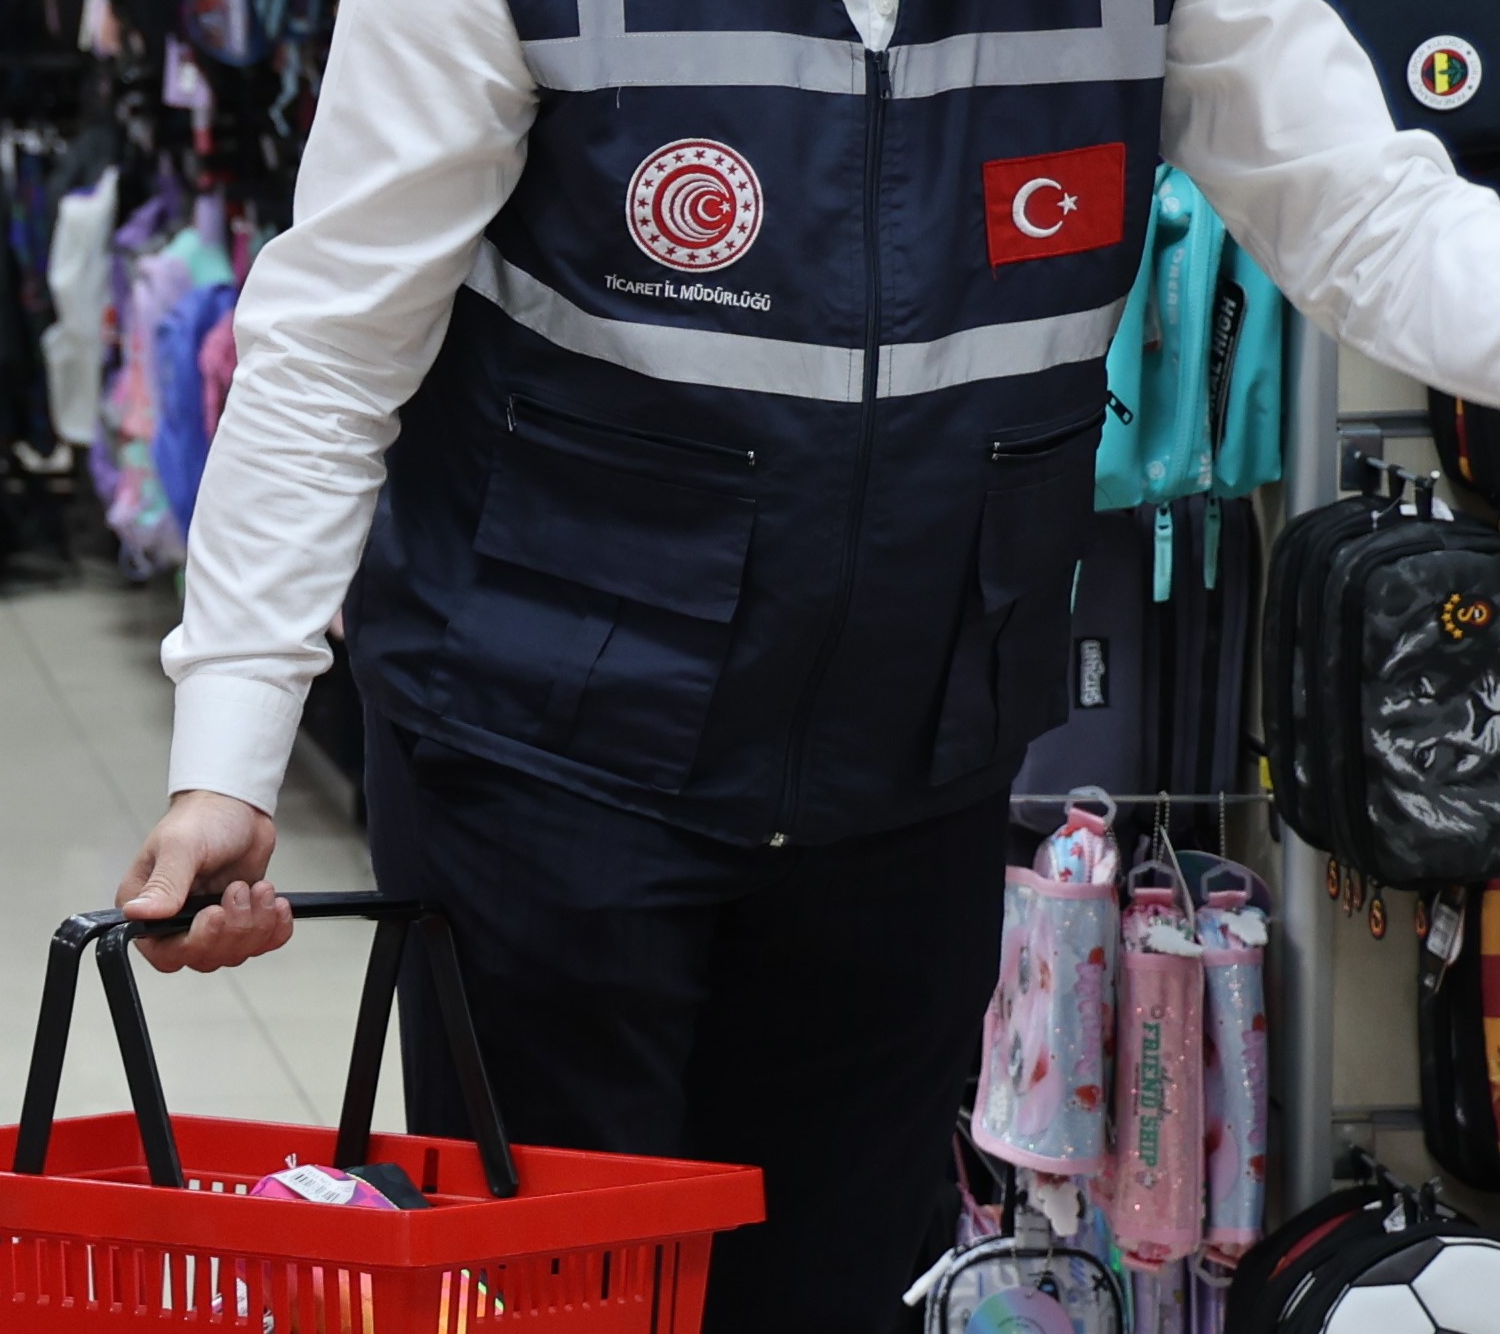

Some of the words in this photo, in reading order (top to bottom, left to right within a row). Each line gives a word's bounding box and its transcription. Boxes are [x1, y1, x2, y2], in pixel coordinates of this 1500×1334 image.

[604, 273, 663, 297] TİCARET
[664, 280, 678, 298] İL
[680, 284, 772, 312] MÜDÜRLÜĞÜ
